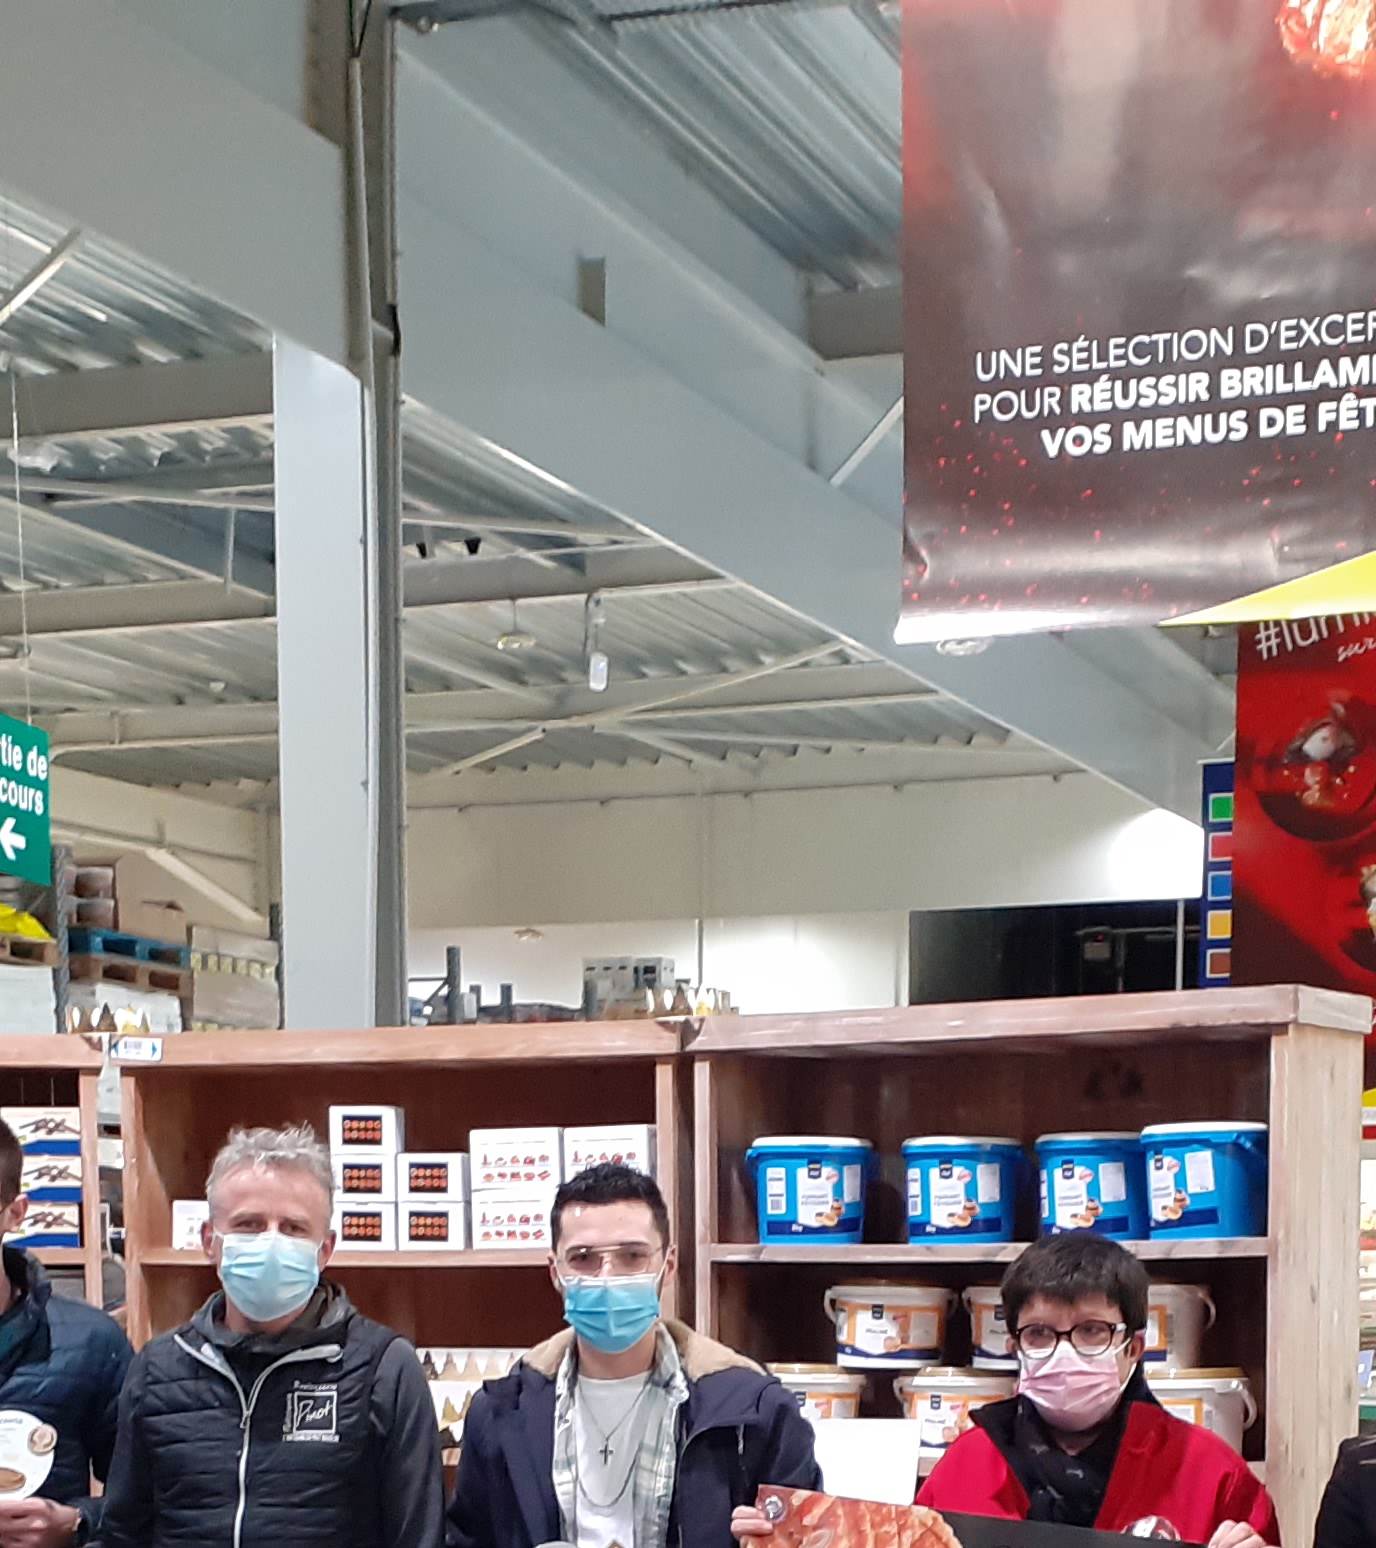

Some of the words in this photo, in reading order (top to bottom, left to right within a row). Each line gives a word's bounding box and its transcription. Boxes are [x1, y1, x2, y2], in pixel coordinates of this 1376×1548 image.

[975, 345, 1043, 382] UNE
[1052, 326, 1234, 374] SÉLECTION
[975, 386, 1062, 424] POUR
[1071, 371, 1210, 414] RÉUSSIR
[1040, 423, 1112, 459] VOS
[1122, 409, 1248, 452] MENUS
[1259, 404, 1307, 438] DE
[1337, 636, 1376, 662] sur
[26, 745, 48, 781] de
